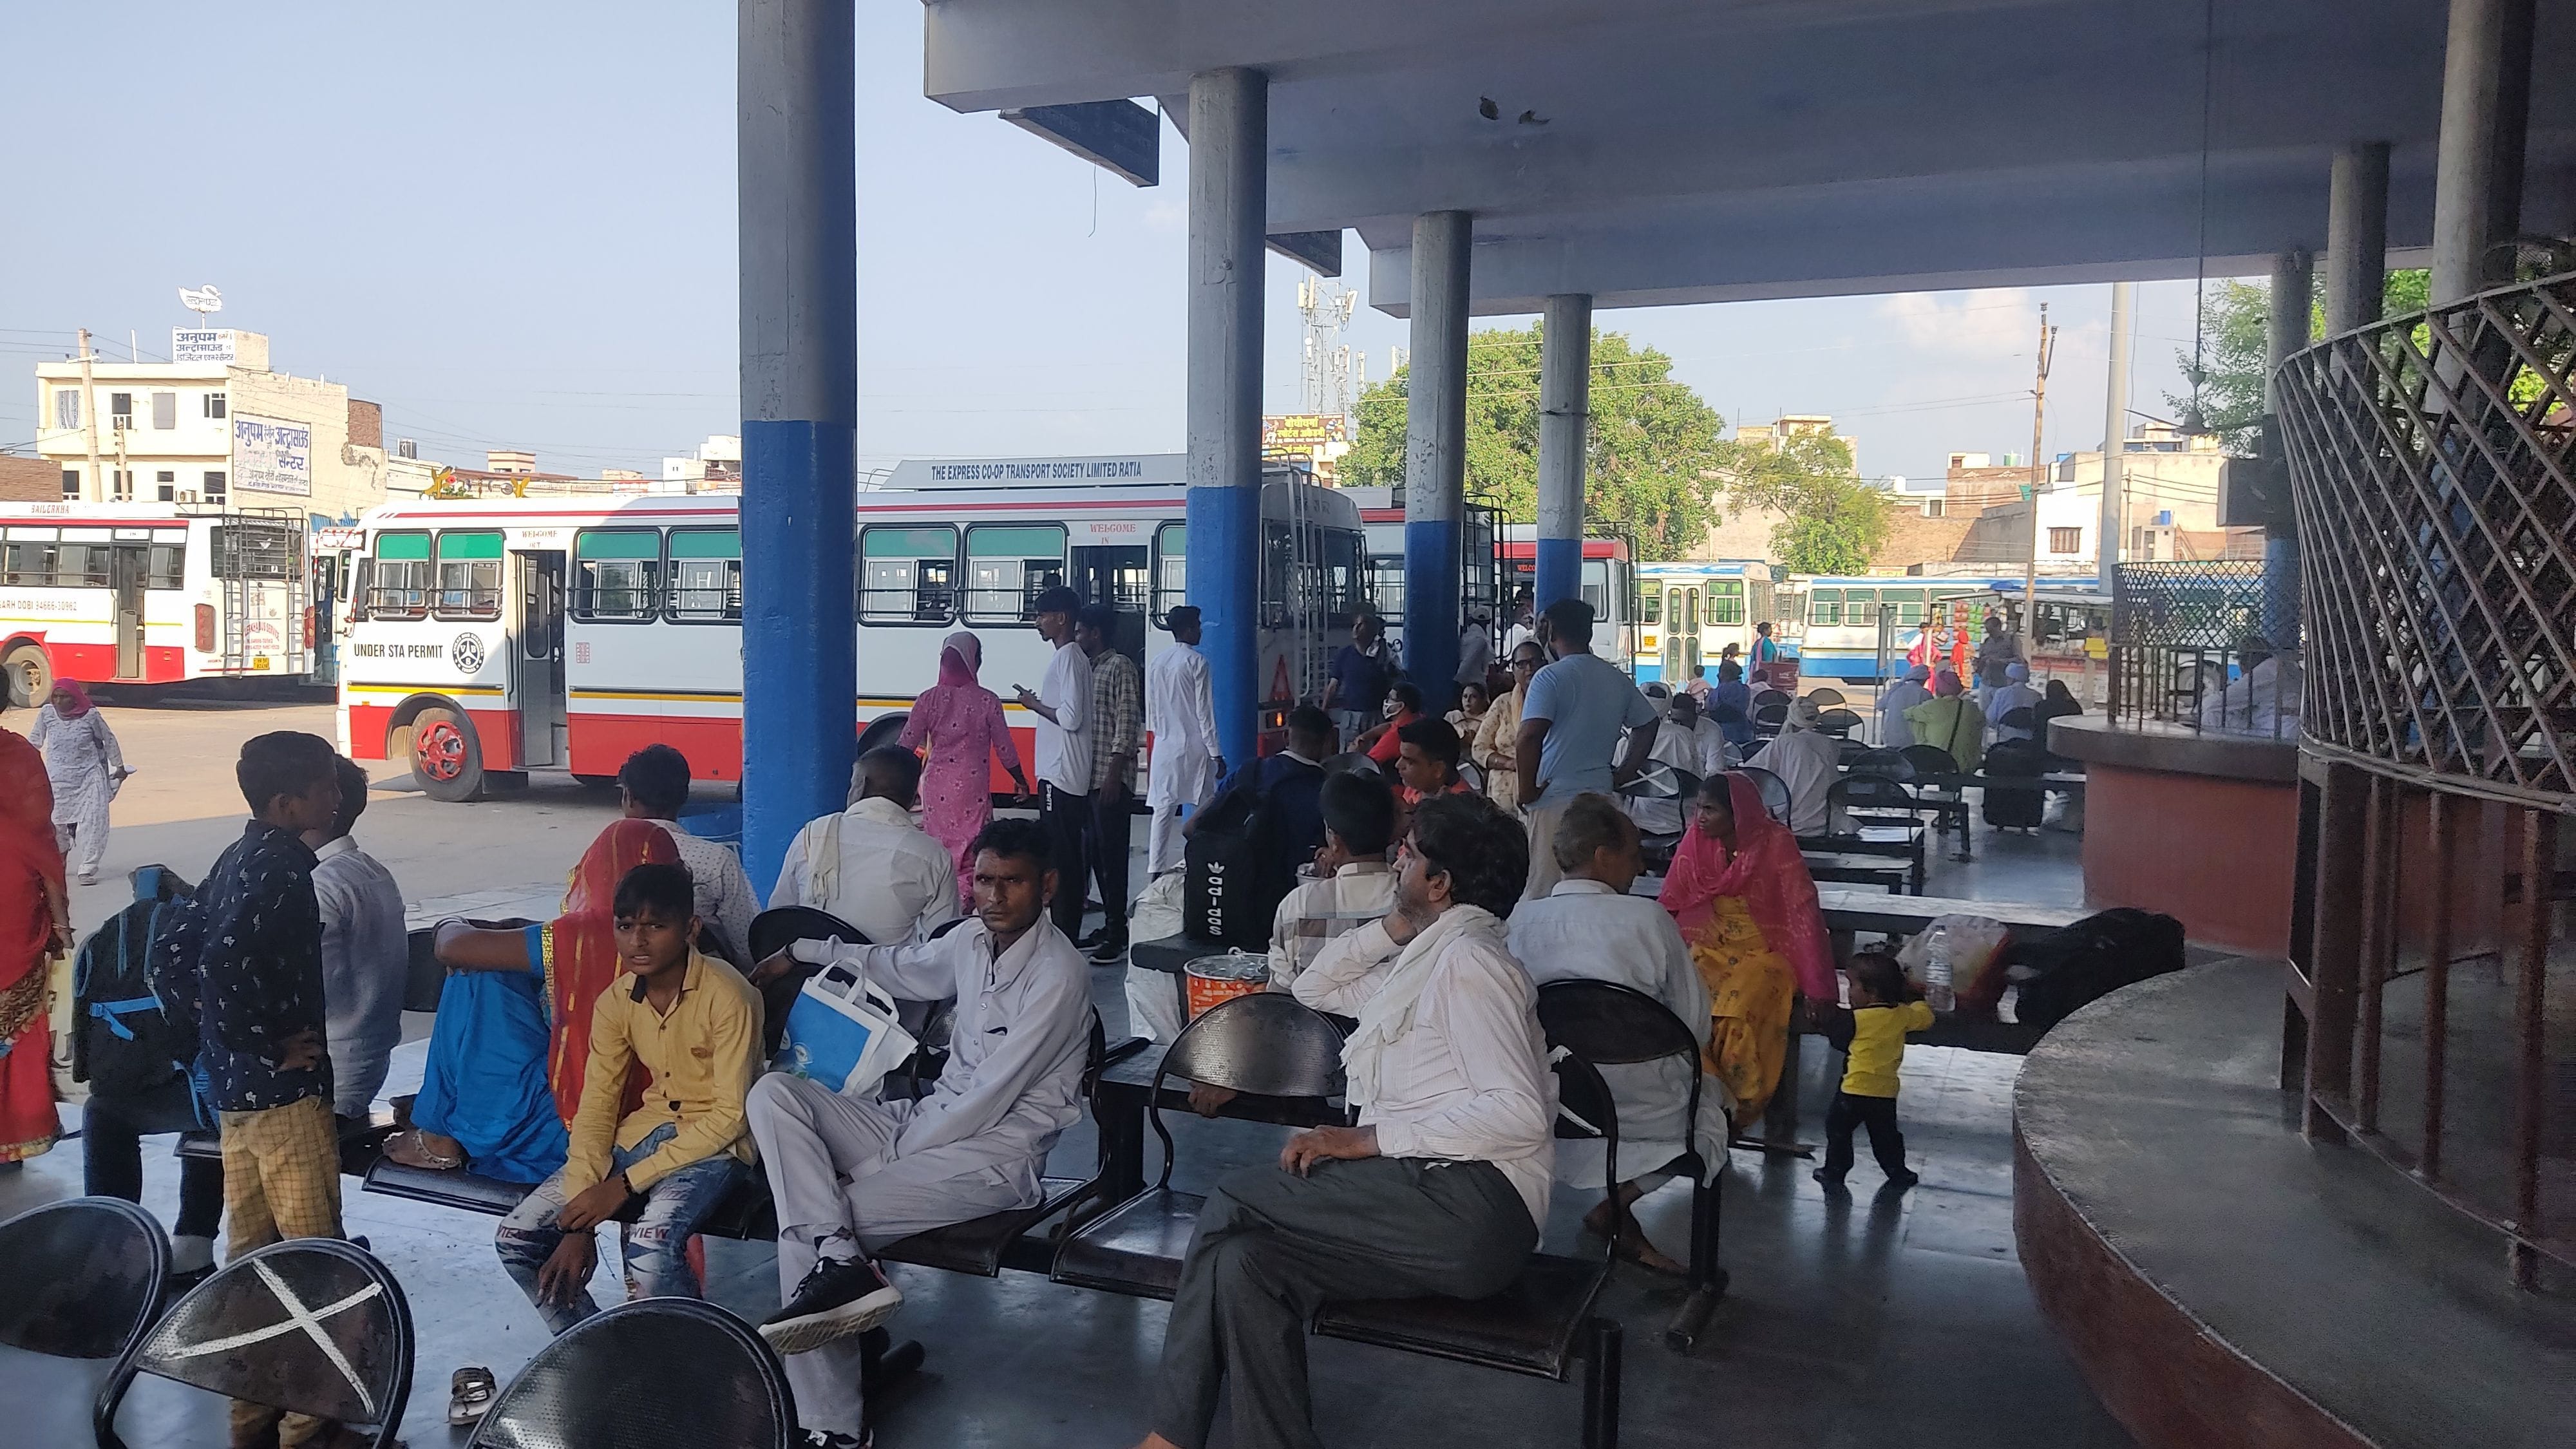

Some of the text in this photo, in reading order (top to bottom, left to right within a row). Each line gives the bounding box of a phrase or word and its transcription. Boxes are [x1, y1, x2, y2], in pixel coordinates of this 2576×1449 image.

[176, 333, 218, 343] अनुपम
[235, 420, 263, 447] अनुपम
[932, 461, 1141, 480] THE EXPRESS CO-OP TRANSPORT SOCIETY LIMITED RATIA
[1090, 524, 1136, 533] WELCOME
[354, 643, 385, 657] UNDER
[388, 644, 404, 658] STA
[408, 645, 443, 658] PERMIT
[1208, 876, 1223, 936] adidas
